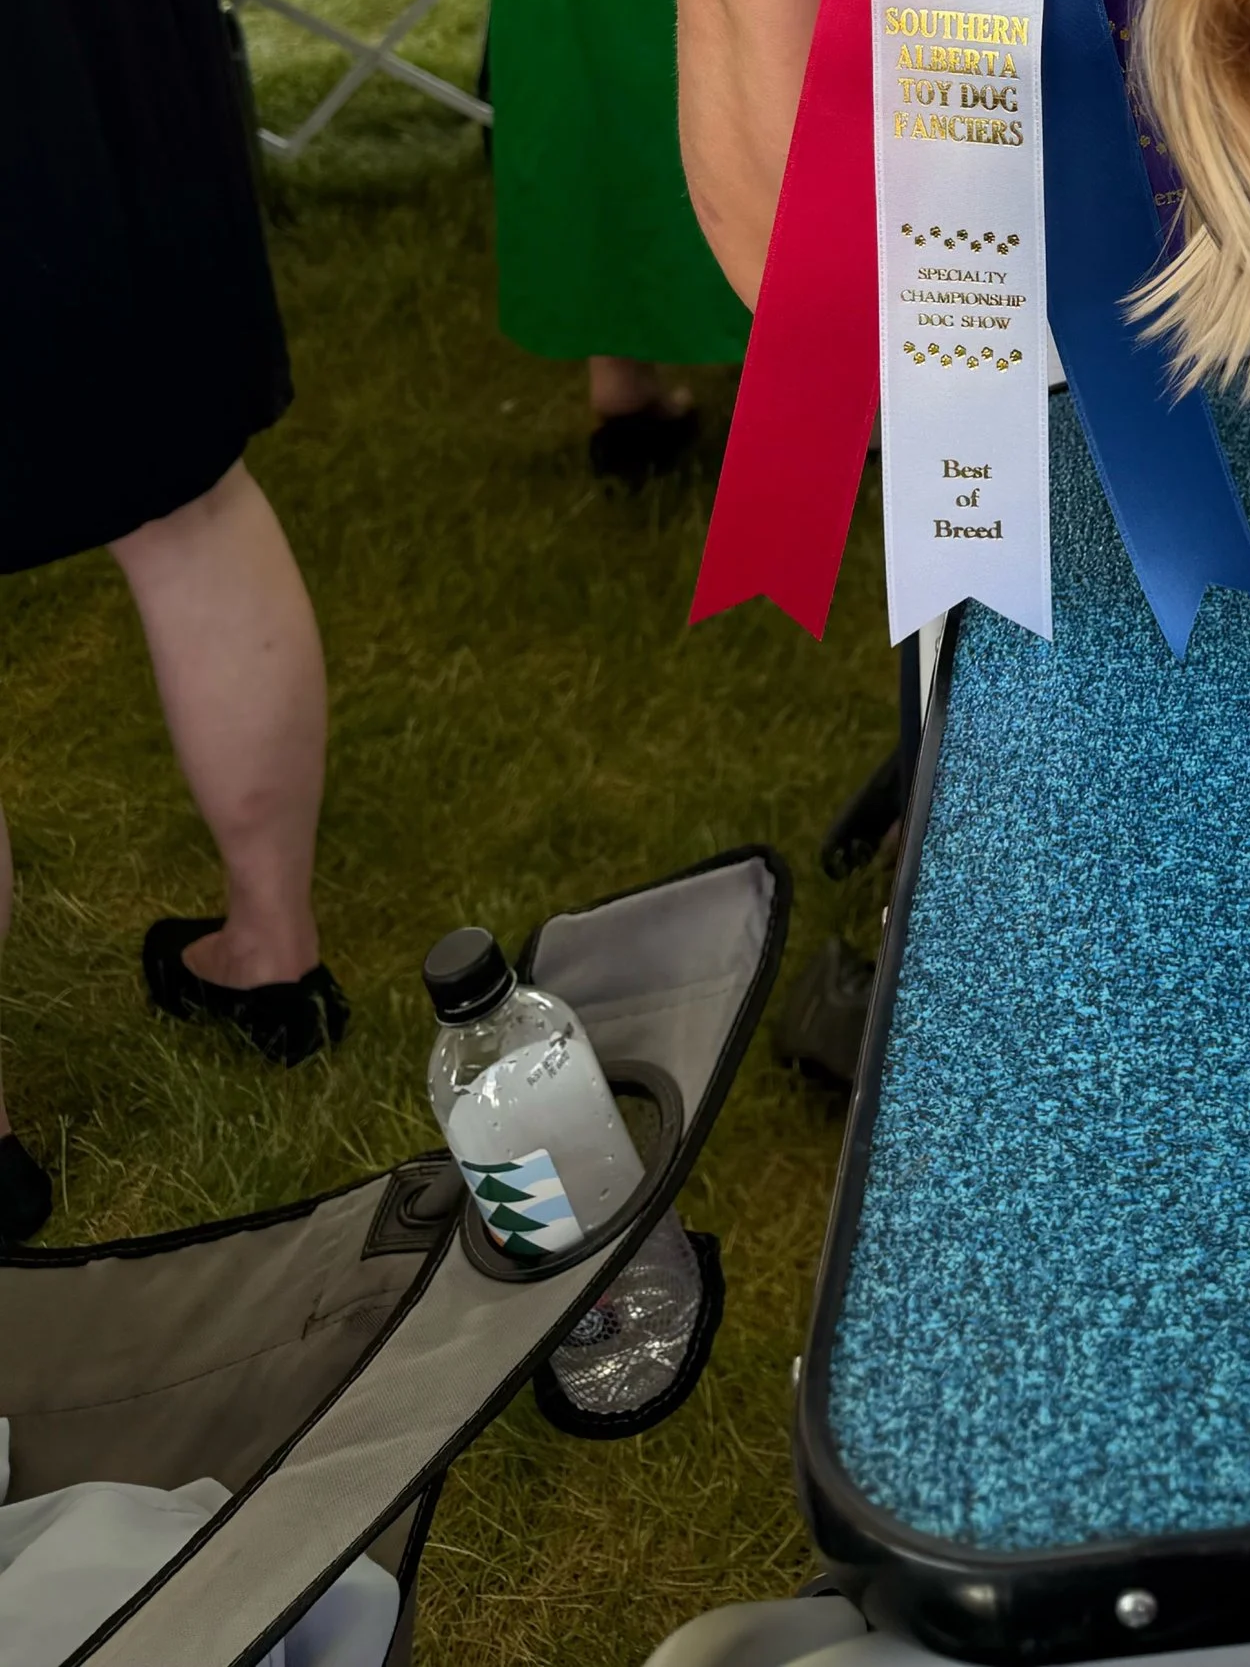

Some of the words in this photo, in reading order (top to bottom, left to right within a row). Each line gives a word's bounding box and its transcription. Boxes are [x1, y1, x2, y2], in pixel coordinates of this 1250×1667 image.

[885, 6, 1030, 46] SOUTHERN
[895, 43, 1020, 79] ALBERTA
[898, 77, 952, 107] TOY
[959, 82, 1019, 113] DOG
[893, 110, 1024, 147] FANCIERS
[917, 266, 1008, 285] SPECIALTY
[900, 289, 1027, 308] CHAMPIONSHIP
[918, 313, 955, 328] DOG
[961, 315, 1012, 331] SHOW
[941, 459, 992, 480] Best
[955, 487, 980, 508] of
[933, 519, 1003, 540] Breed
